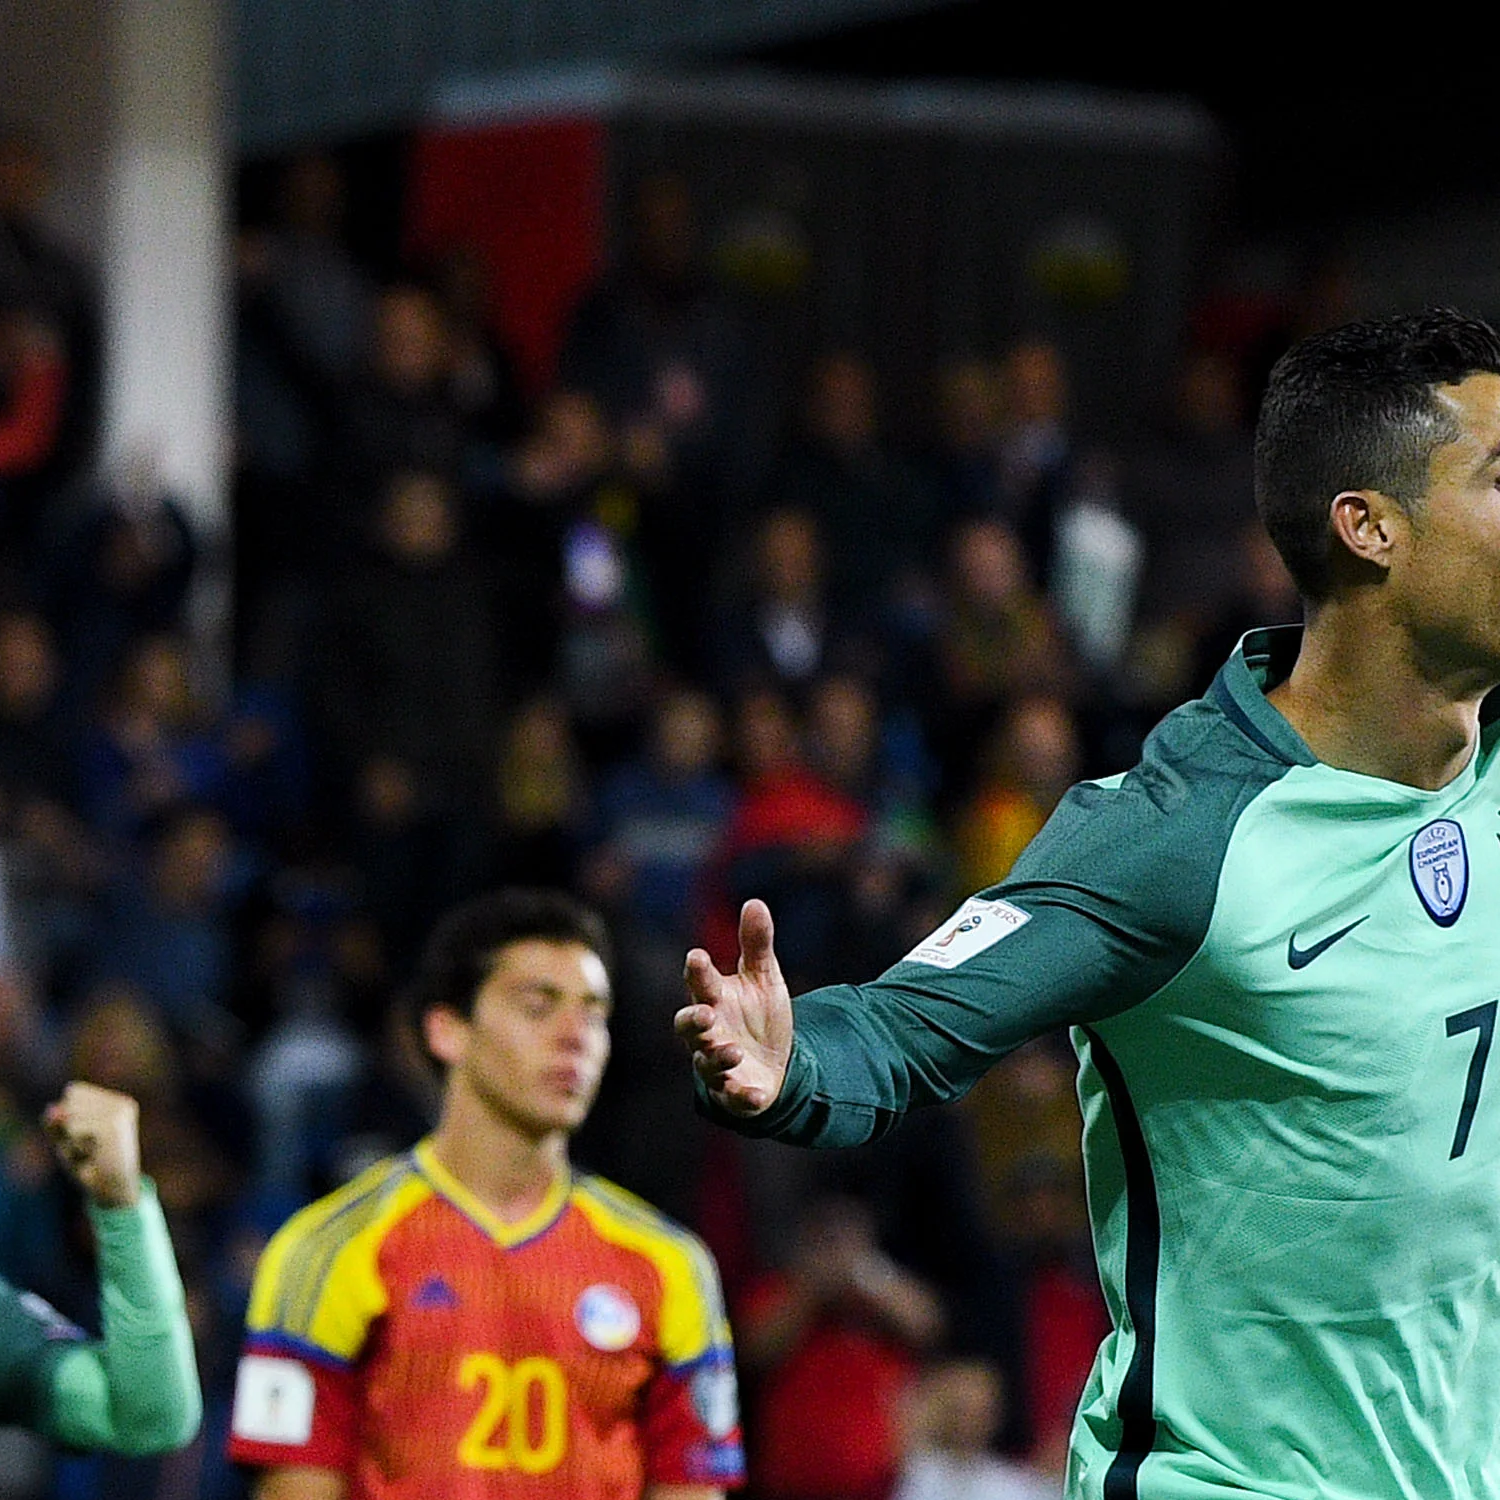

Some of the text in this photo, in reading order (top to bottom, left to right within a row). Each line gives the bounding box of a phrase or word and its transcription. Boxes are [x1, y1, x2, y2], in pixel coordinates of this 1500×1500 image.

[1416, 839, 1458, 860] EUROPEAN
[1445, 999, 1499, 1161] 7
[457, 1351, 567, 1474] 20
